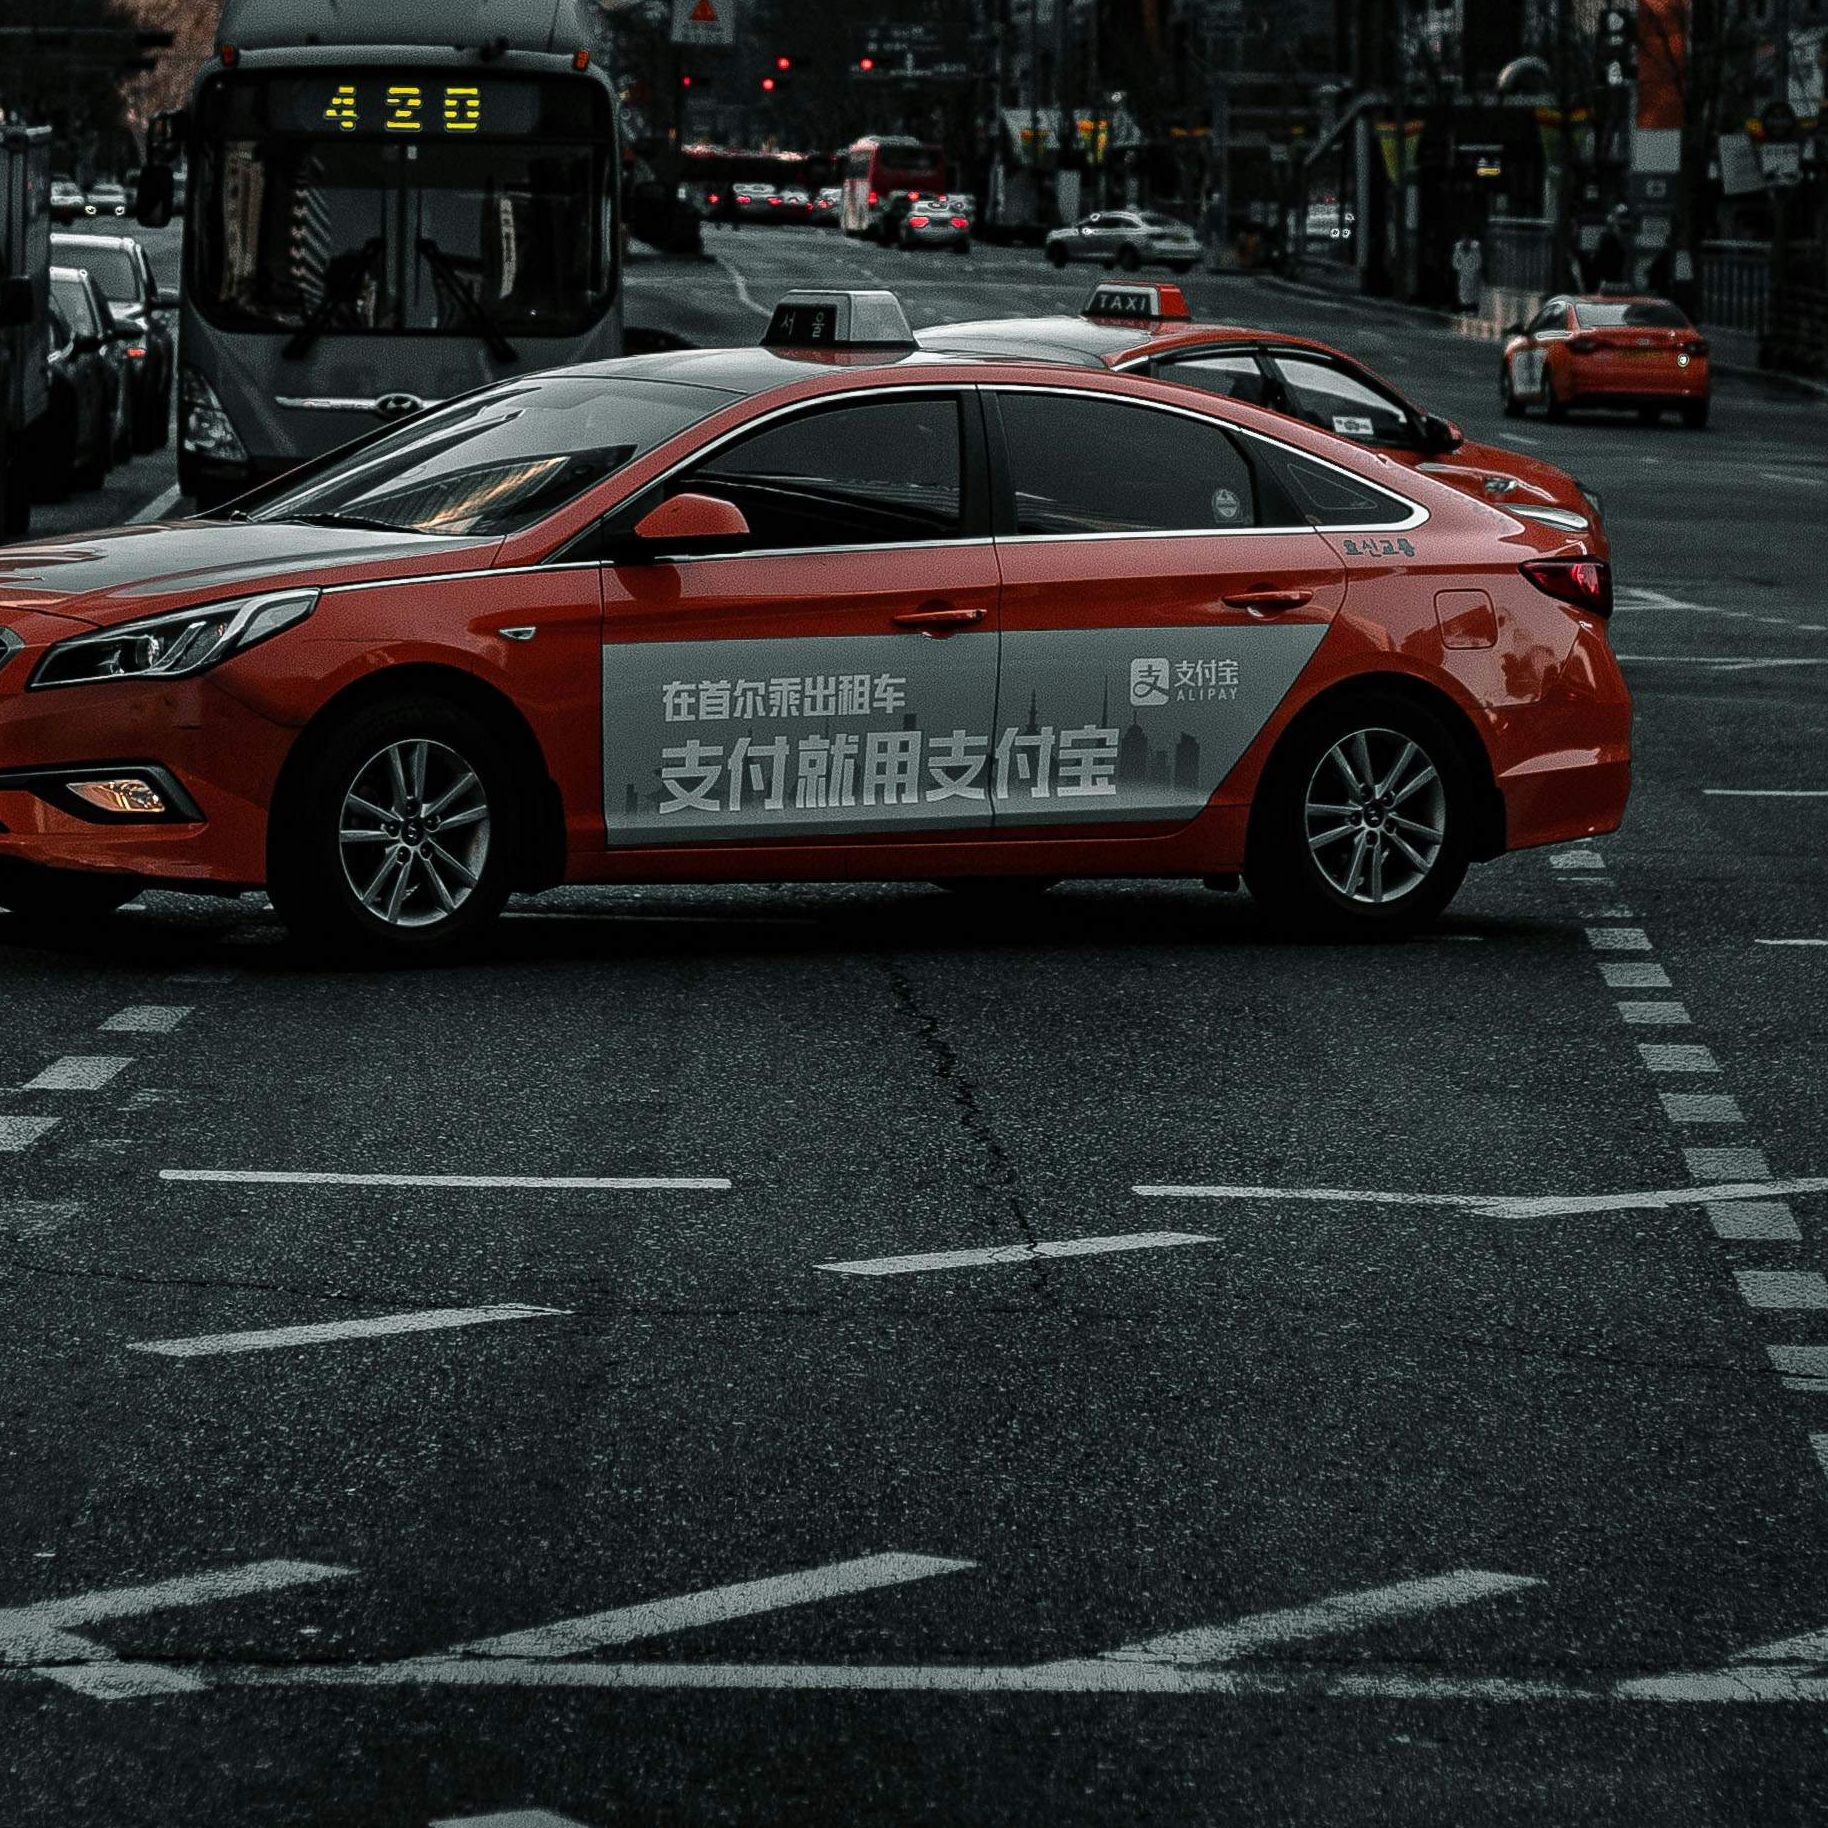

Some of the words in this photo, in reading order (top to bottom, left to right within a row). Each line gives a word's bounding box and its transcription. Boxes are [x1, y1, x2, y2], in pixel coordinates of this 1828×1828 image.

[325, 86, 480, 130] 420
[1099, 293, 1147, 311] TAXI
[779, 310, 826, 338] 서울
[1174, 659, 1239, 688] 支付宝
[662, 673, 907, 723] 在首尔乘出租车
[1176, 687, 1238, 702] ALIPAY
[658, 723, 1120, 815] 支付就用支付宝
